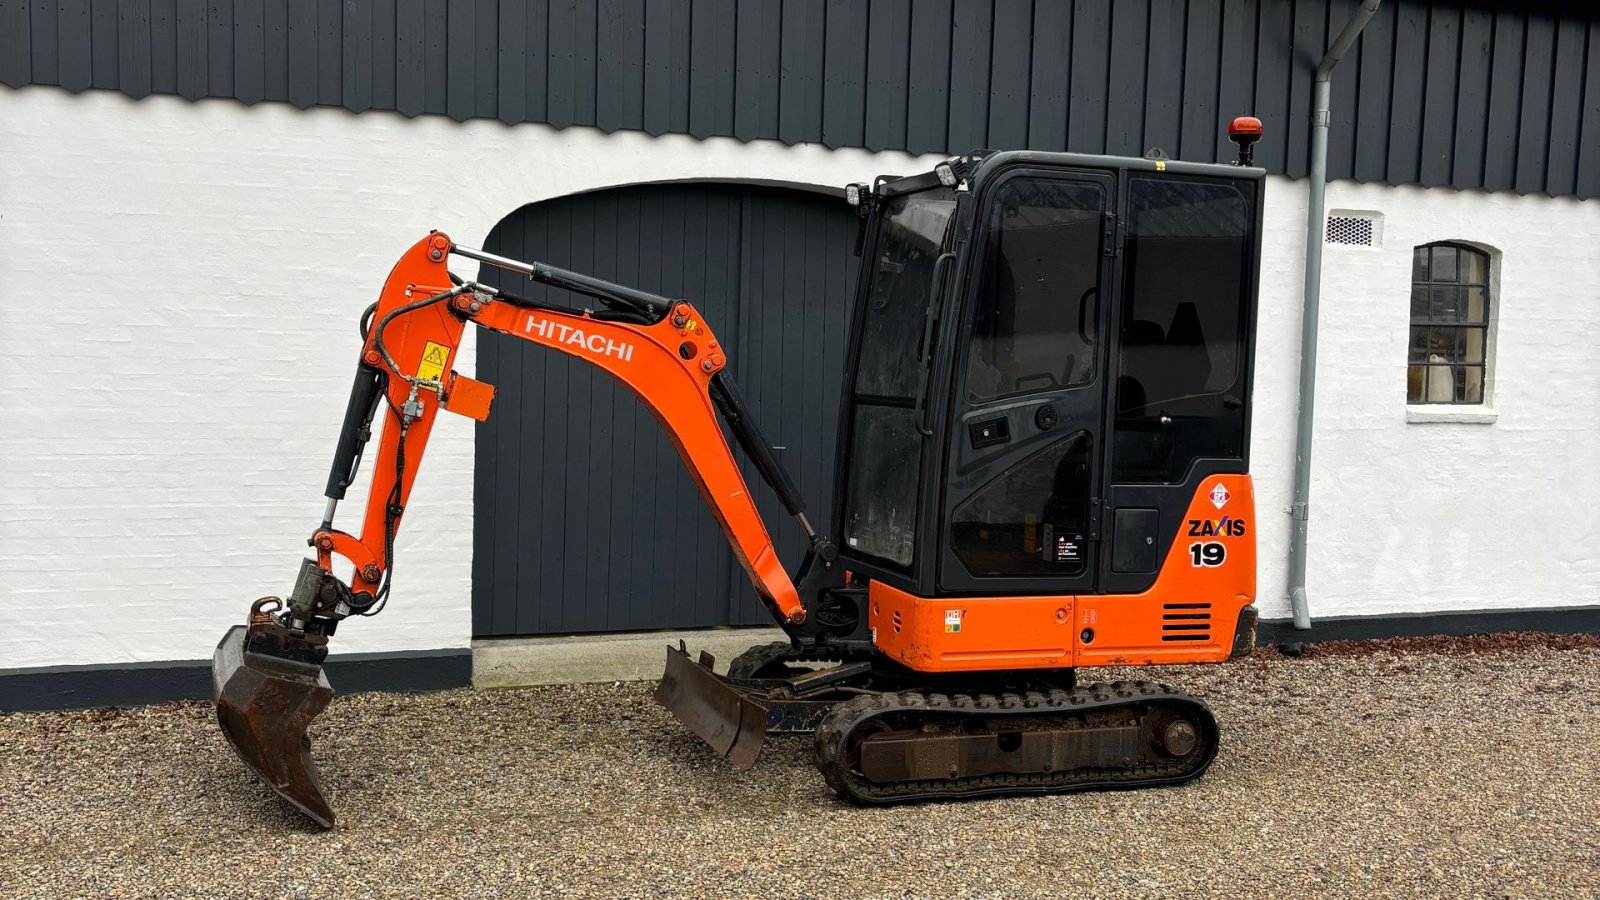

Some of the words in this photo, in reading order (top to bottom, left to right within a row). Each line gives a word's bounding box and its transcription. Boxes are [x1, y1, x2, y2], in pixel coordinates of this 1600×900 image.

[525, 315, 634, 361] HITACHI
[1188, 516, 1245, 537] ZAXIS
[1190, 542, 1226, 566] 19
